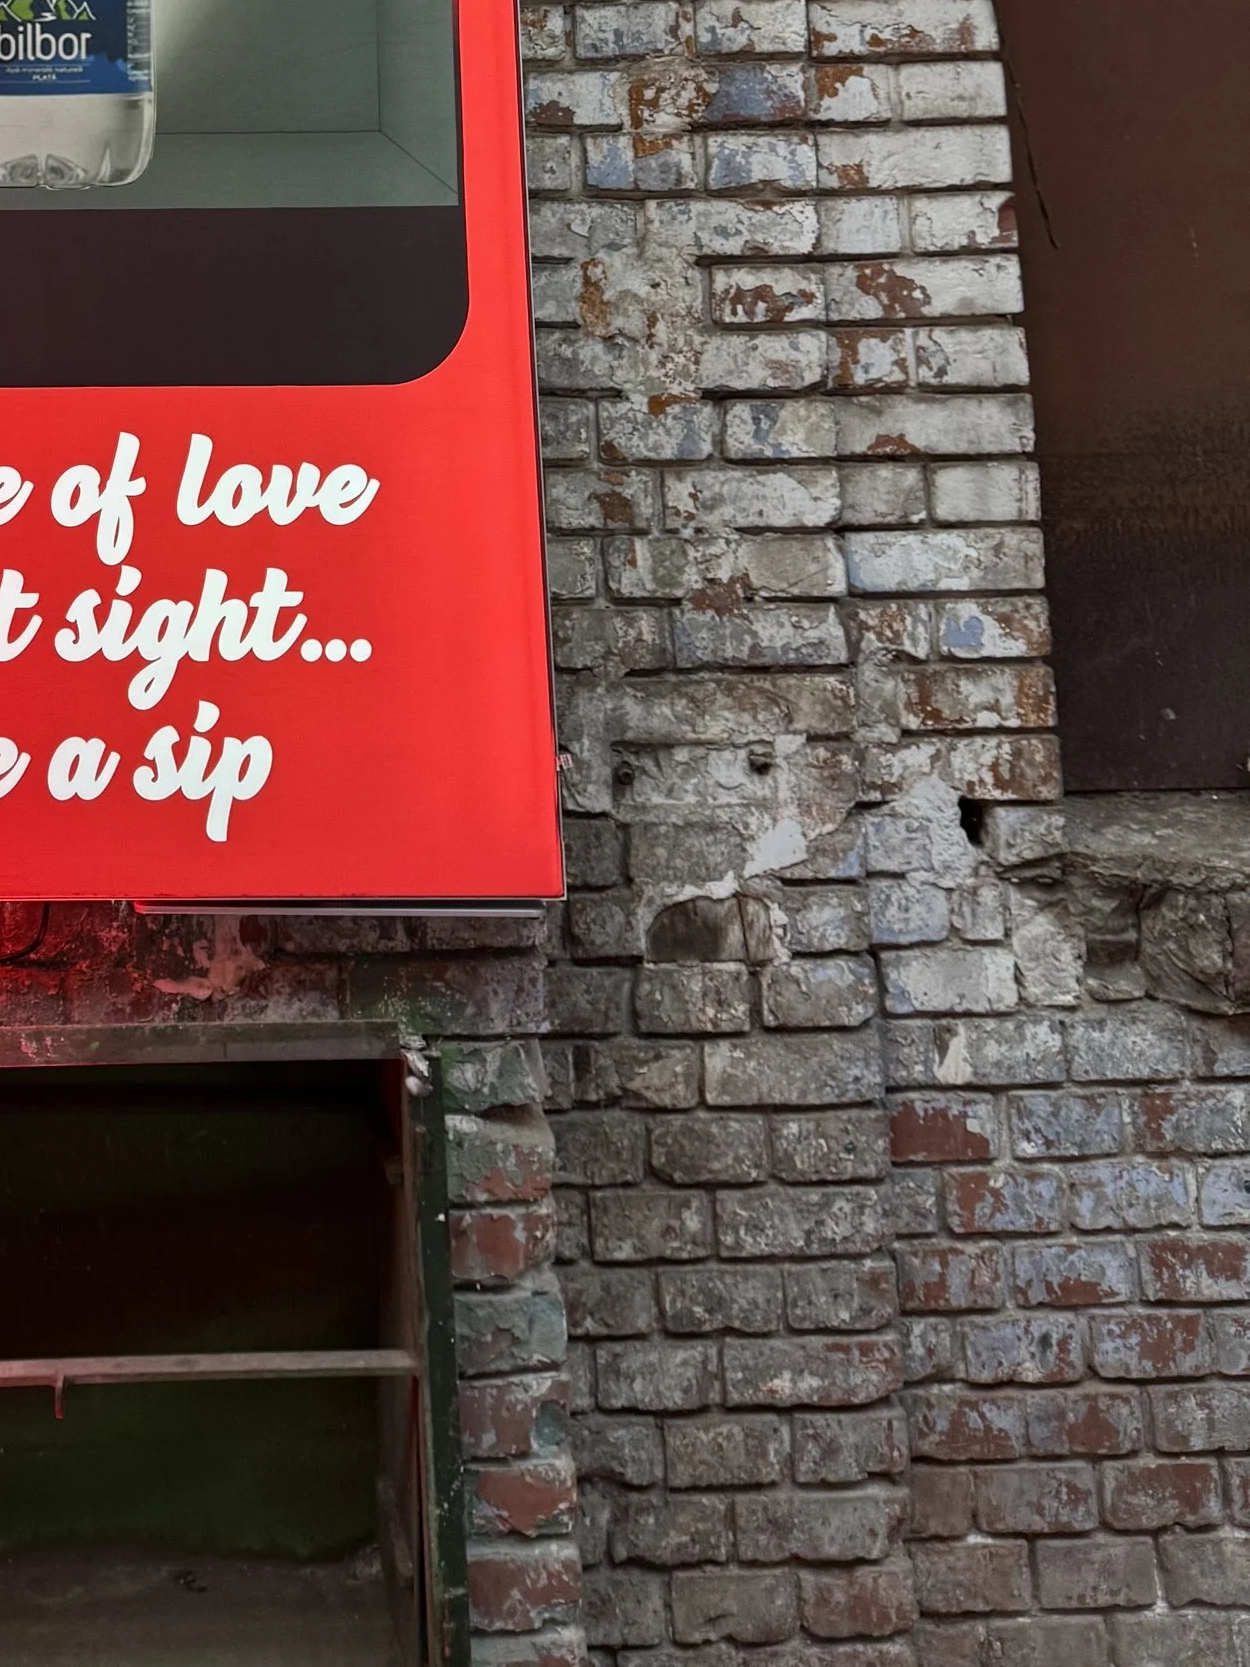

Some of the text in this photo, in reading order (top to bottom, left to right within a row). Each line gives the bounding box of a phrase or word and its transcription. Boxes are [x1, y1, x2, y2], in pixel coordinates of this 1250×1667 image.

[50, 431, 146, 566] of
[176, 433, 381, 527] love
[54, 564, 373, 711] sight...
[47, 736, 121, 801] a
[132, 700, 273, 842] sip
